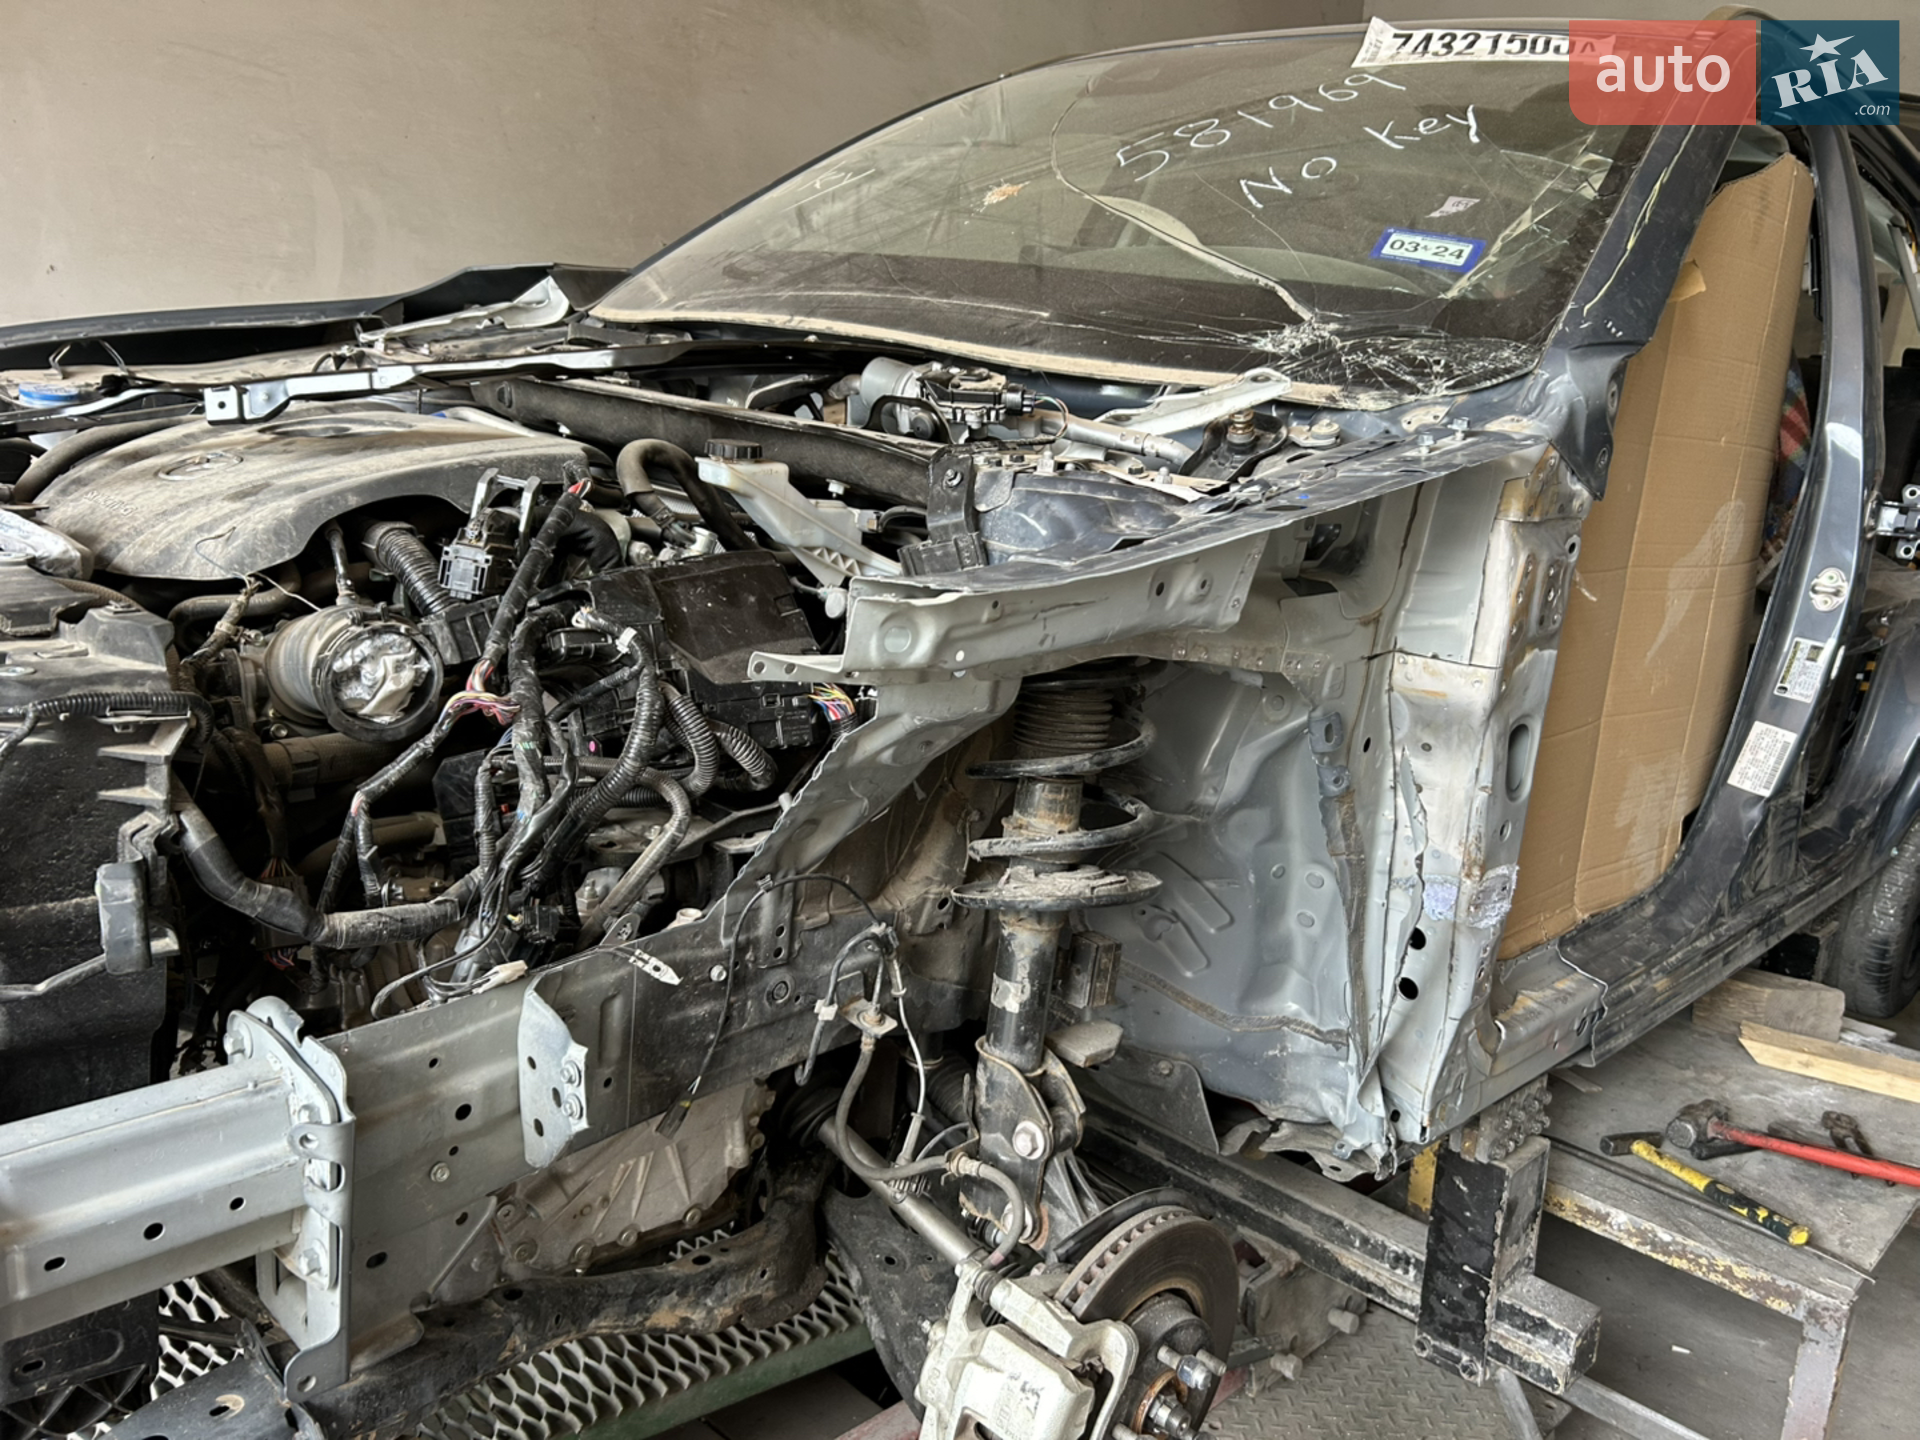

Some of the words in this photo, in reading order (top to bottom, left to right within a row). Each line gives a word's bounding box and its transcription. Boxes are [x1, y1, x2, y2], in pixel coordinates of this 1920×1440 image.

[1116, 74, 1406, 182] 581969
[1239, 156, 1337, 208] No
[1389, 239, 1421, 253] 03
[1432, 245, 1465, 260] 24
